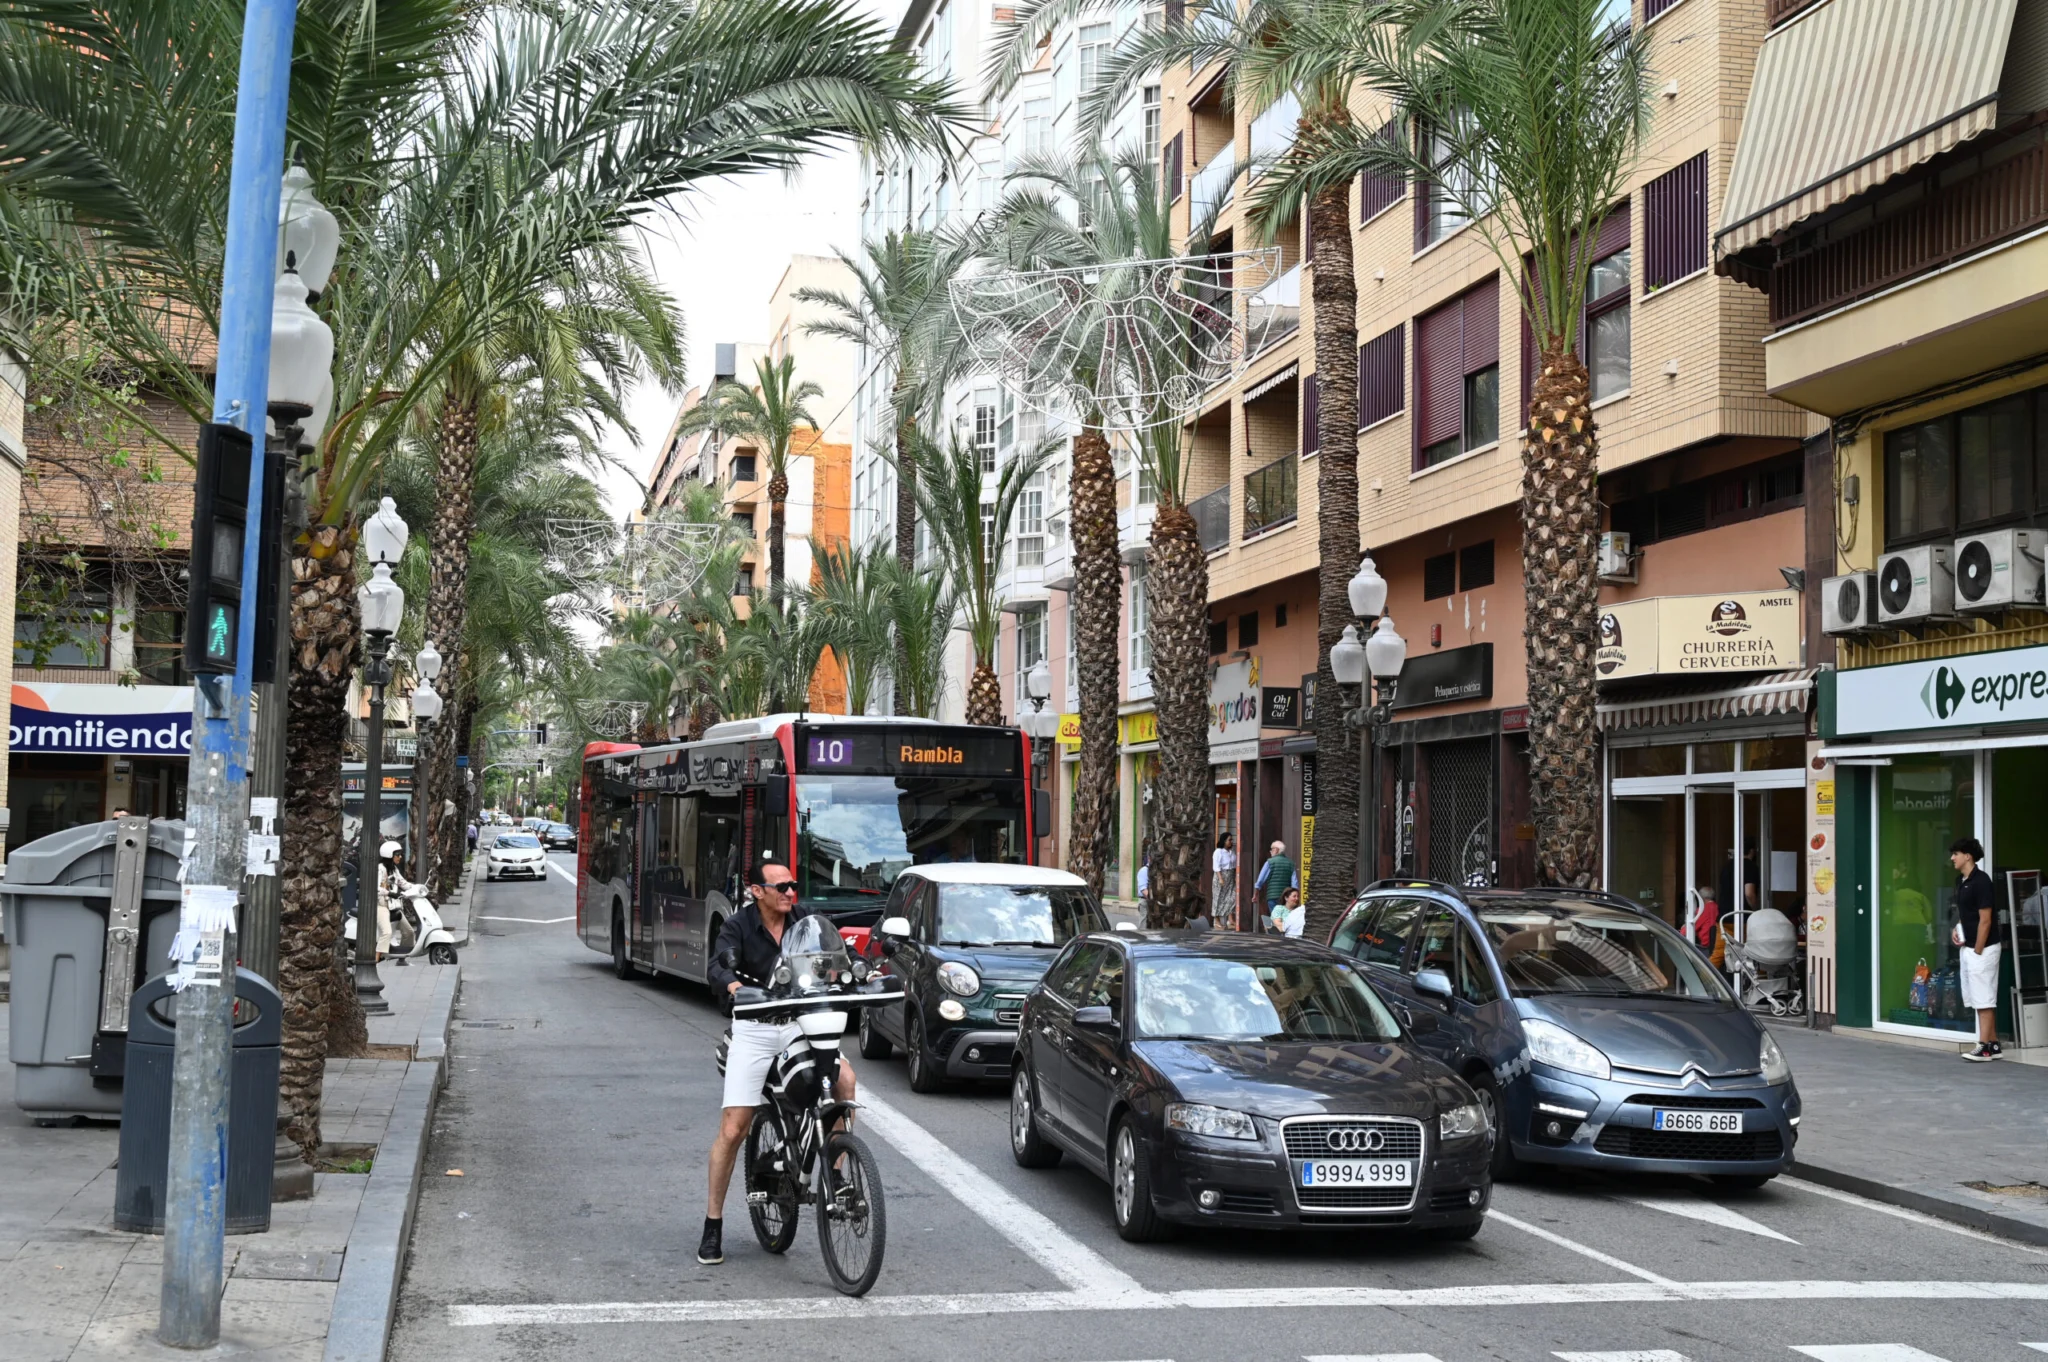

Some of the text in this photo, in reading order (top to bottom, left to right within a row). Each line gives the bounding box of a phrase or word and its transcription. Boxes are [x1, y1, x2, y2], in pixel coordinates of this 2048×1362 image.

[1759, 597, 1794, 607] AMSTEL
[1683, 637, 1774, 654] CHURRERÍA
[1679, 652, 1778, 669] CERVECERÍA
[1273, 694, 1286, 704] Oh
[1971, 670, 2048, 711] expre
[1271, 710, 1285, 718] Cut
[1273, 703, 1286, 711] my
[817, 740, 963, 763] 10 Rambla
[1303, 782, 1312, 796] MY
[1303, 796, 1312, 810] OH
[1303, 819, 1312, 858] ORIGINAL
[1666, 1113, 1737, 1130] 6666 66B
[1316, 1164, 1364, 1182] 9994
[1369, 1164, 1406, 1181] 999
